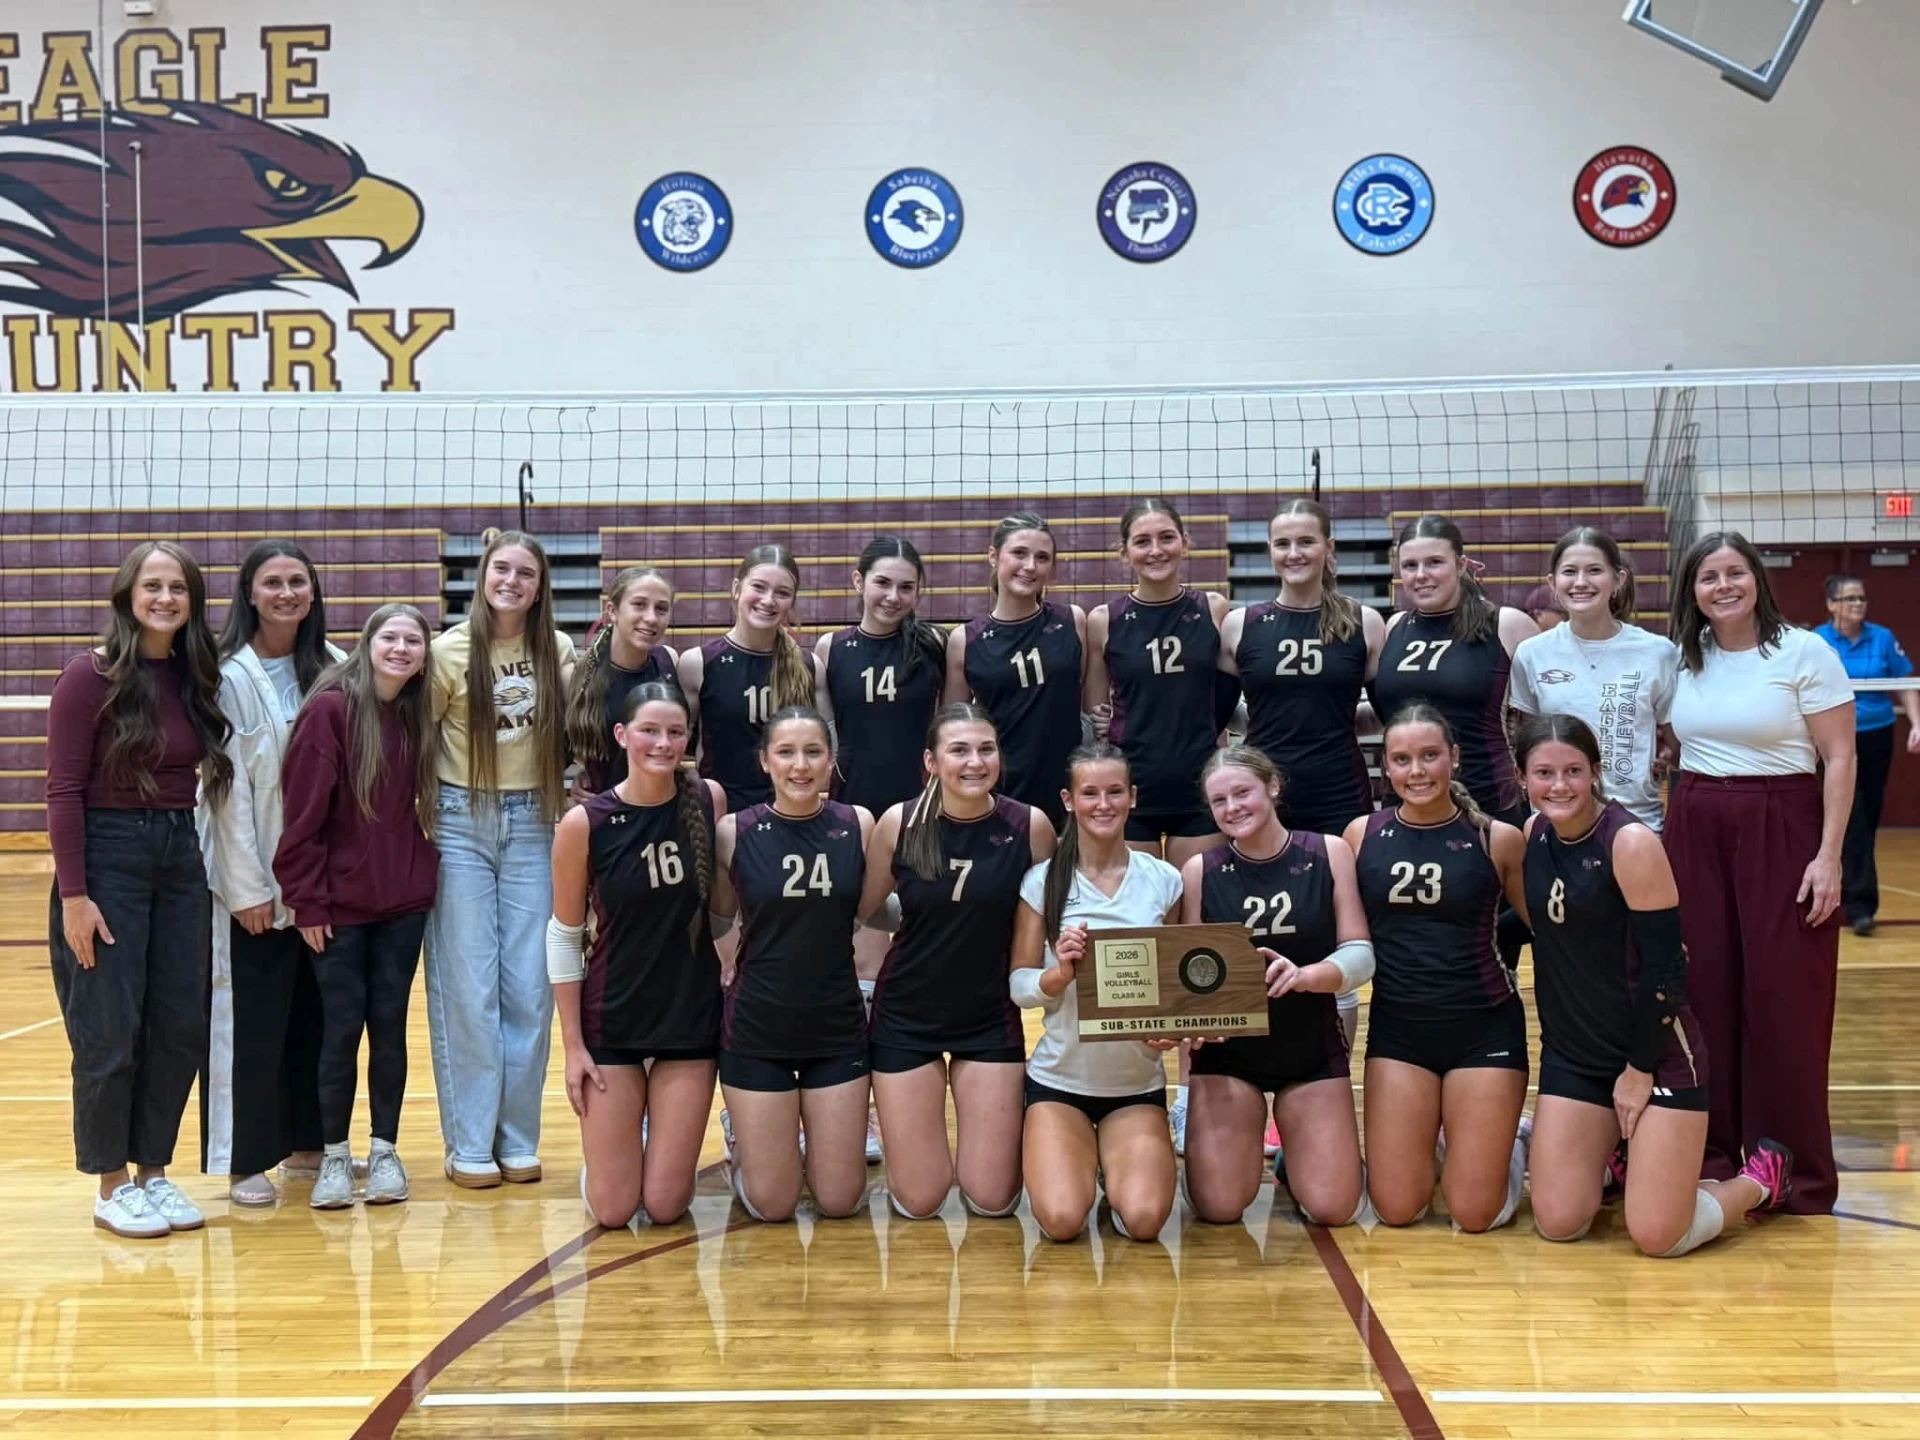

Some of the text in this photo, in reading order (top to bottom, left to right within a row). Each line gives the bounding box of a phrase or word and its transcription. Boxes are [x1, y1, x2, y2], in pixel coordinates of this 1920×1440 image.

[1886, 496, 1912, 517] EXIT
[1010, 647, 1045, 688] 11
[1145, 635, 1185, 674] 12
[1276, 638, 1323, 676] 25
[1397, 639, 1453, 672] 27
[860, 665, 897, 703] 14
[744, 685, 771, 723] 10
[1614, 670, 1641, 786] VOLLEYBALL
[640, 840, 684, 888] 16
[782, 853, 833, 898] 24
[949, 858, 973, 902] 7
[1388, 860, 1443, 904] 23
[1243, 891, 1296, 936] 22
[1547, 877, 1565, 924] 8
[1115, 950, 1139, 960] 2026
[1104, 979, 1153, 987] VOLLEYBALL
[1116, 971, 1140, 979] GIRLS
[1112, 992, 1135, 1000] CLASS
[1100, 1016, 1248, 1031] SUB-STATE CHAMPIONS
